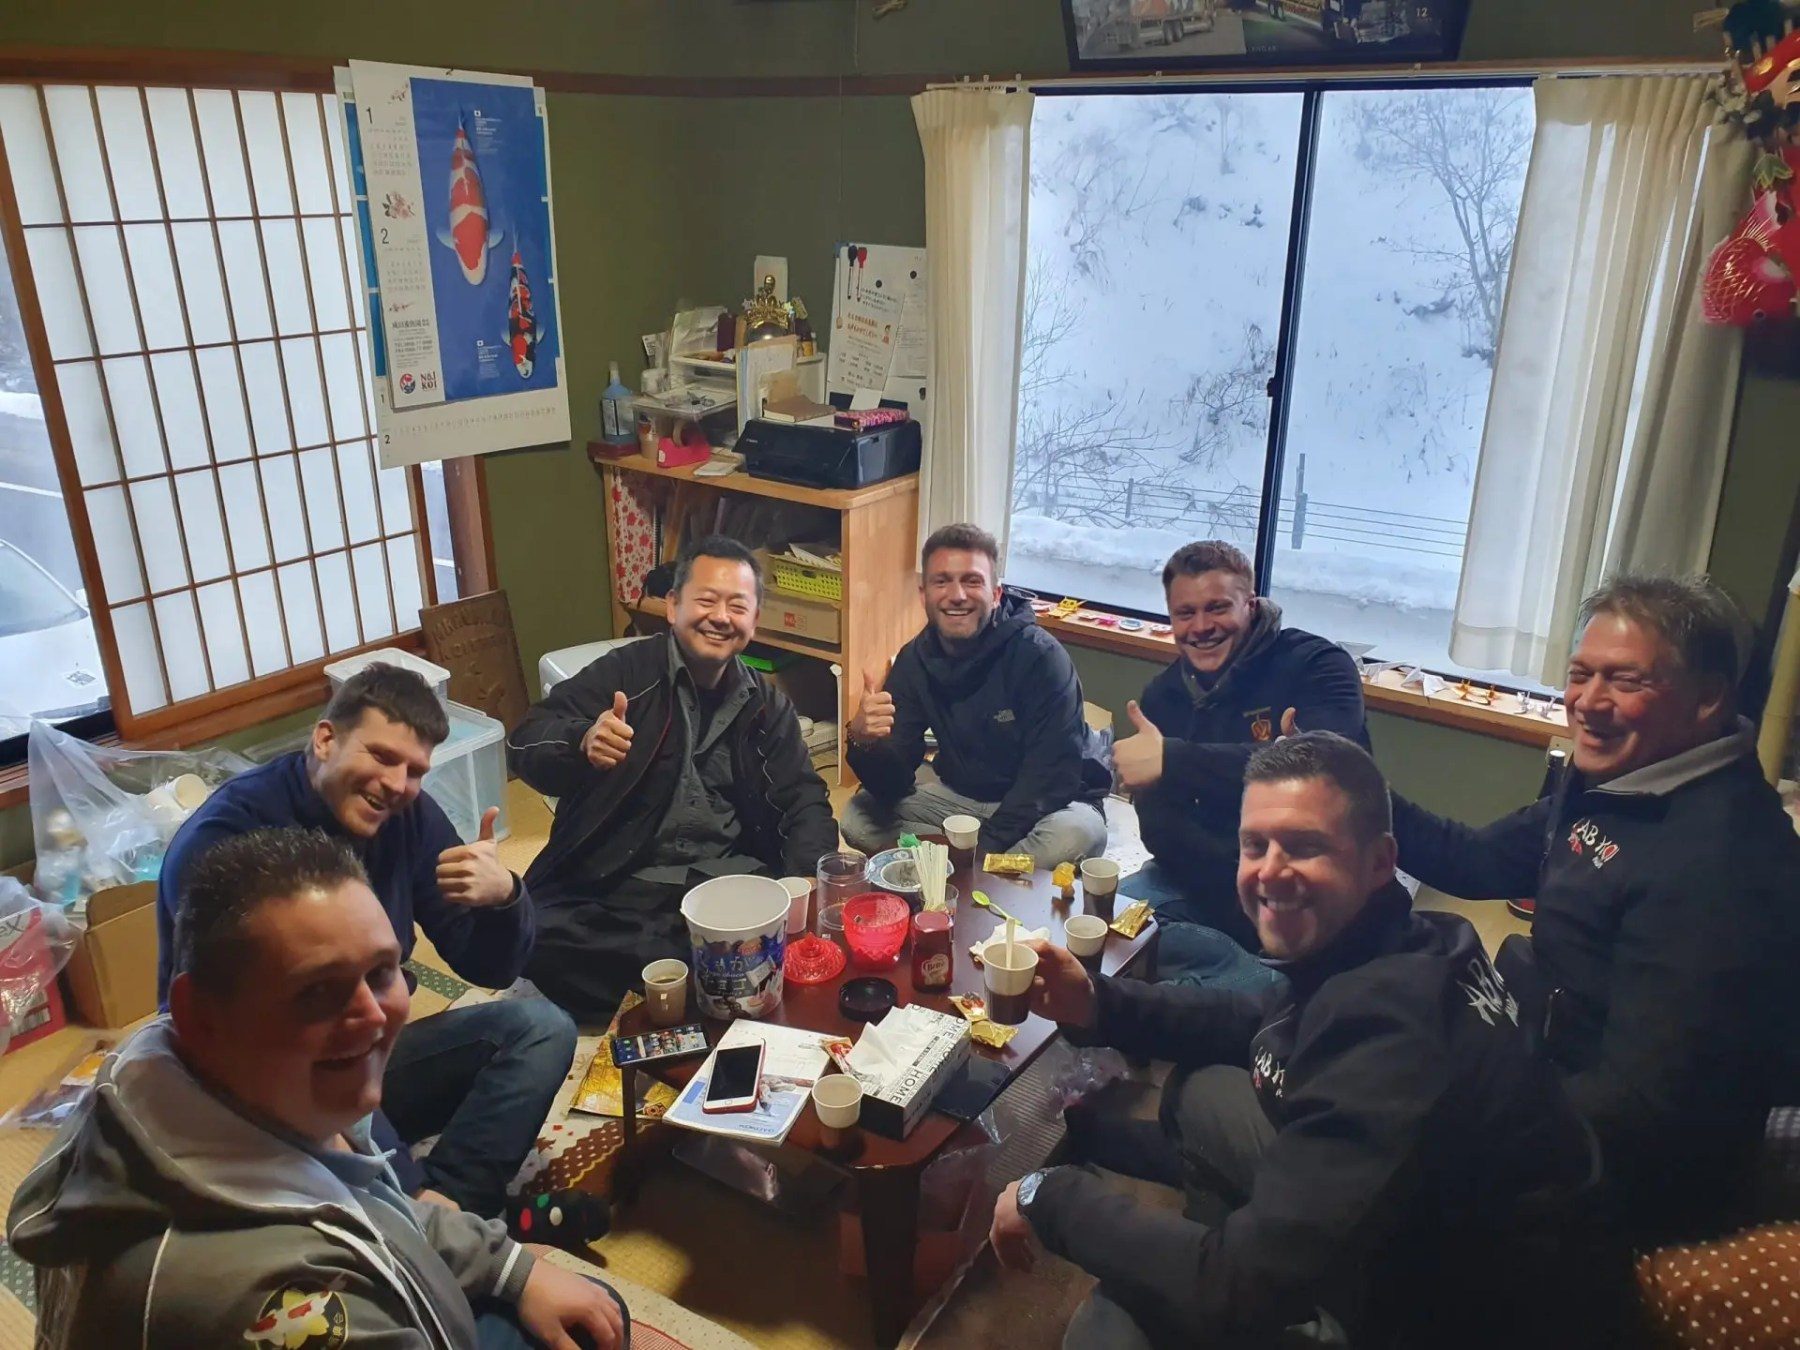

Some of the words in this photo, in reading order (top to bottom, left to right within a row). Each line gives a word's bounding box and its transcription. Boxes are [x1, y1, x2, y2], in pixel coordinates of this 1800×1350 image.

[1416, 7, 1428, 18] 12
[366, 106, 373, 124] 1
[380, 227, 390, 244] 2
[943, 1017, 966, 1039] OME
[889, 1069, 923, 1104] HOME
